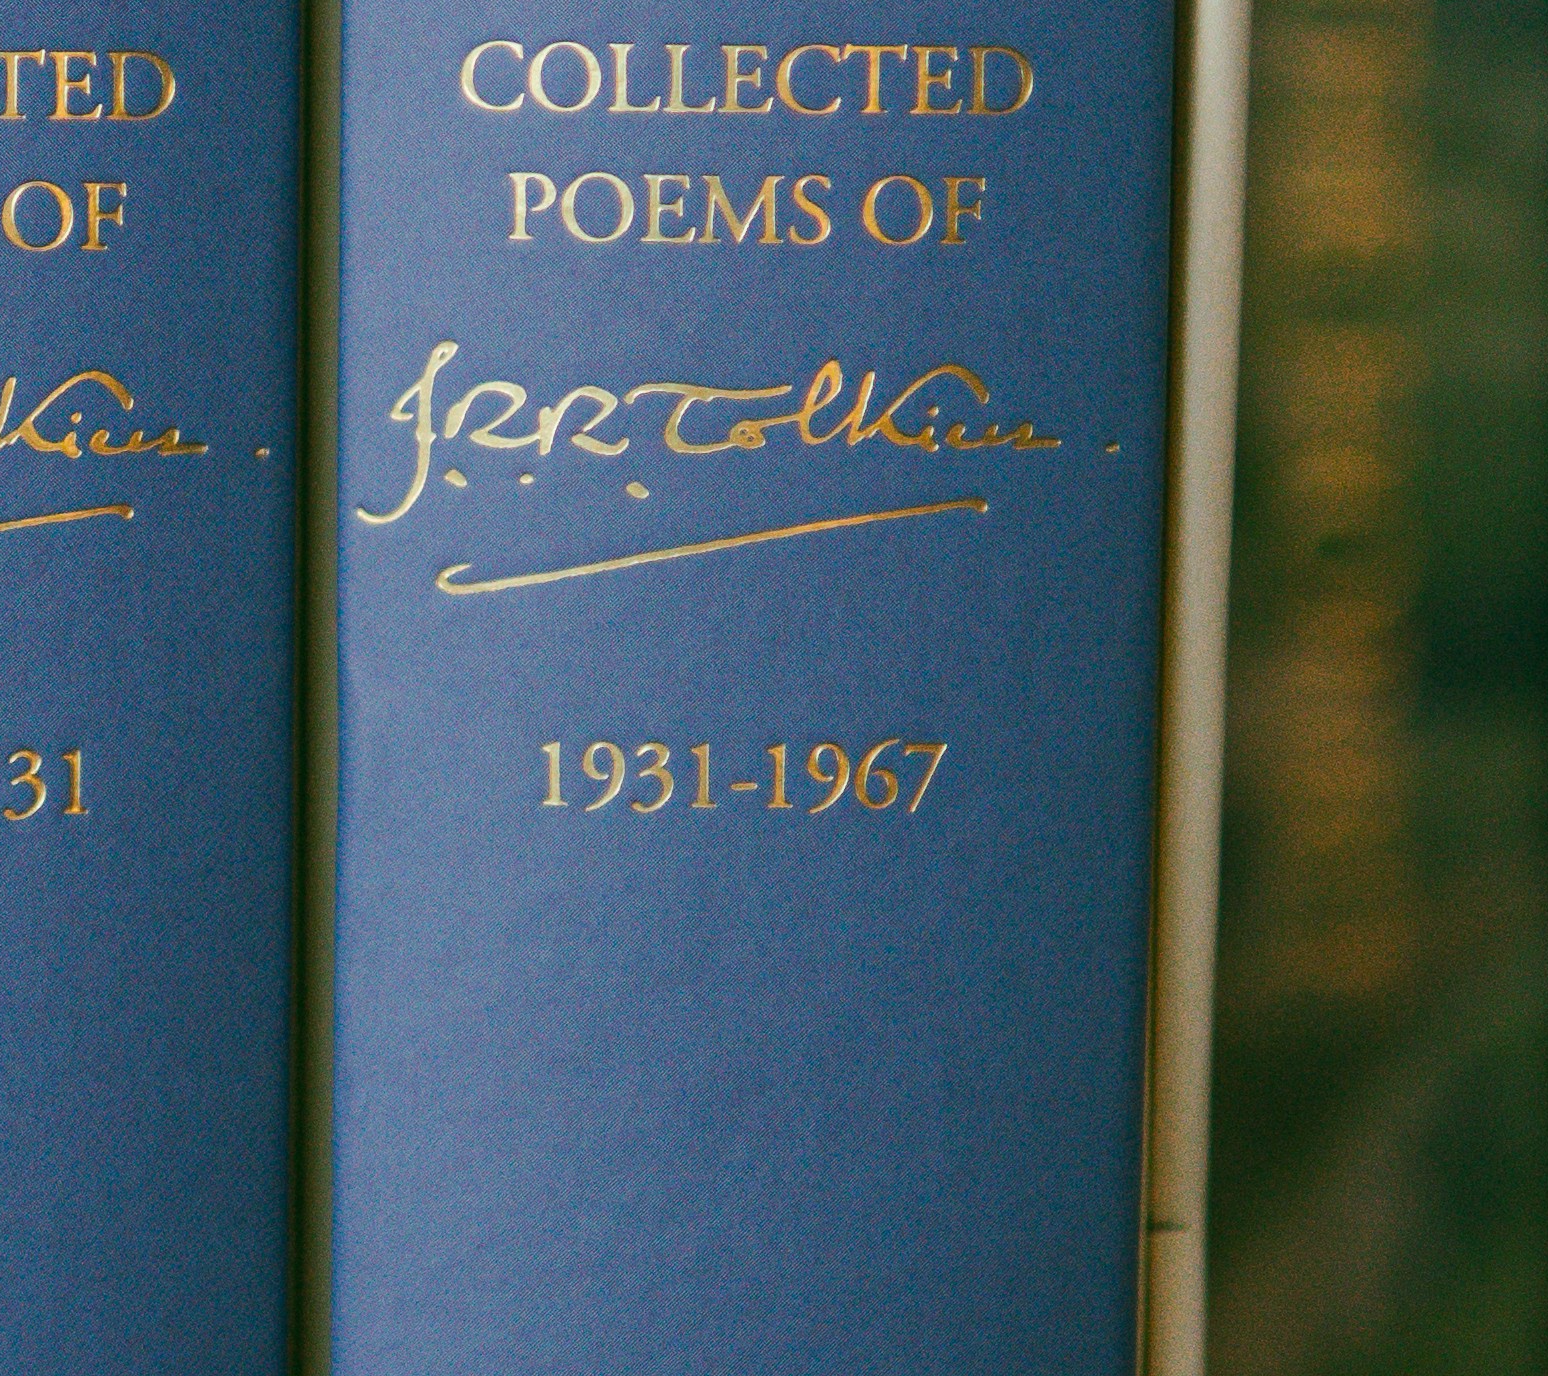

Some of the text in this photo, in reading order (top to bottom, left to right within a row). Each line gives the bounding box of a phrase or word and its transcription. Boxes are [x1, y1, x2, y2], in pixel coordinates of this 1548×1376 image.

[457, 39, 1034, 118] COLLECTED
[0, 178, 128, 253] OF
[506, 170, 988, 247] POEMS OF
[540, 736, 947, 815] 1931-1967
